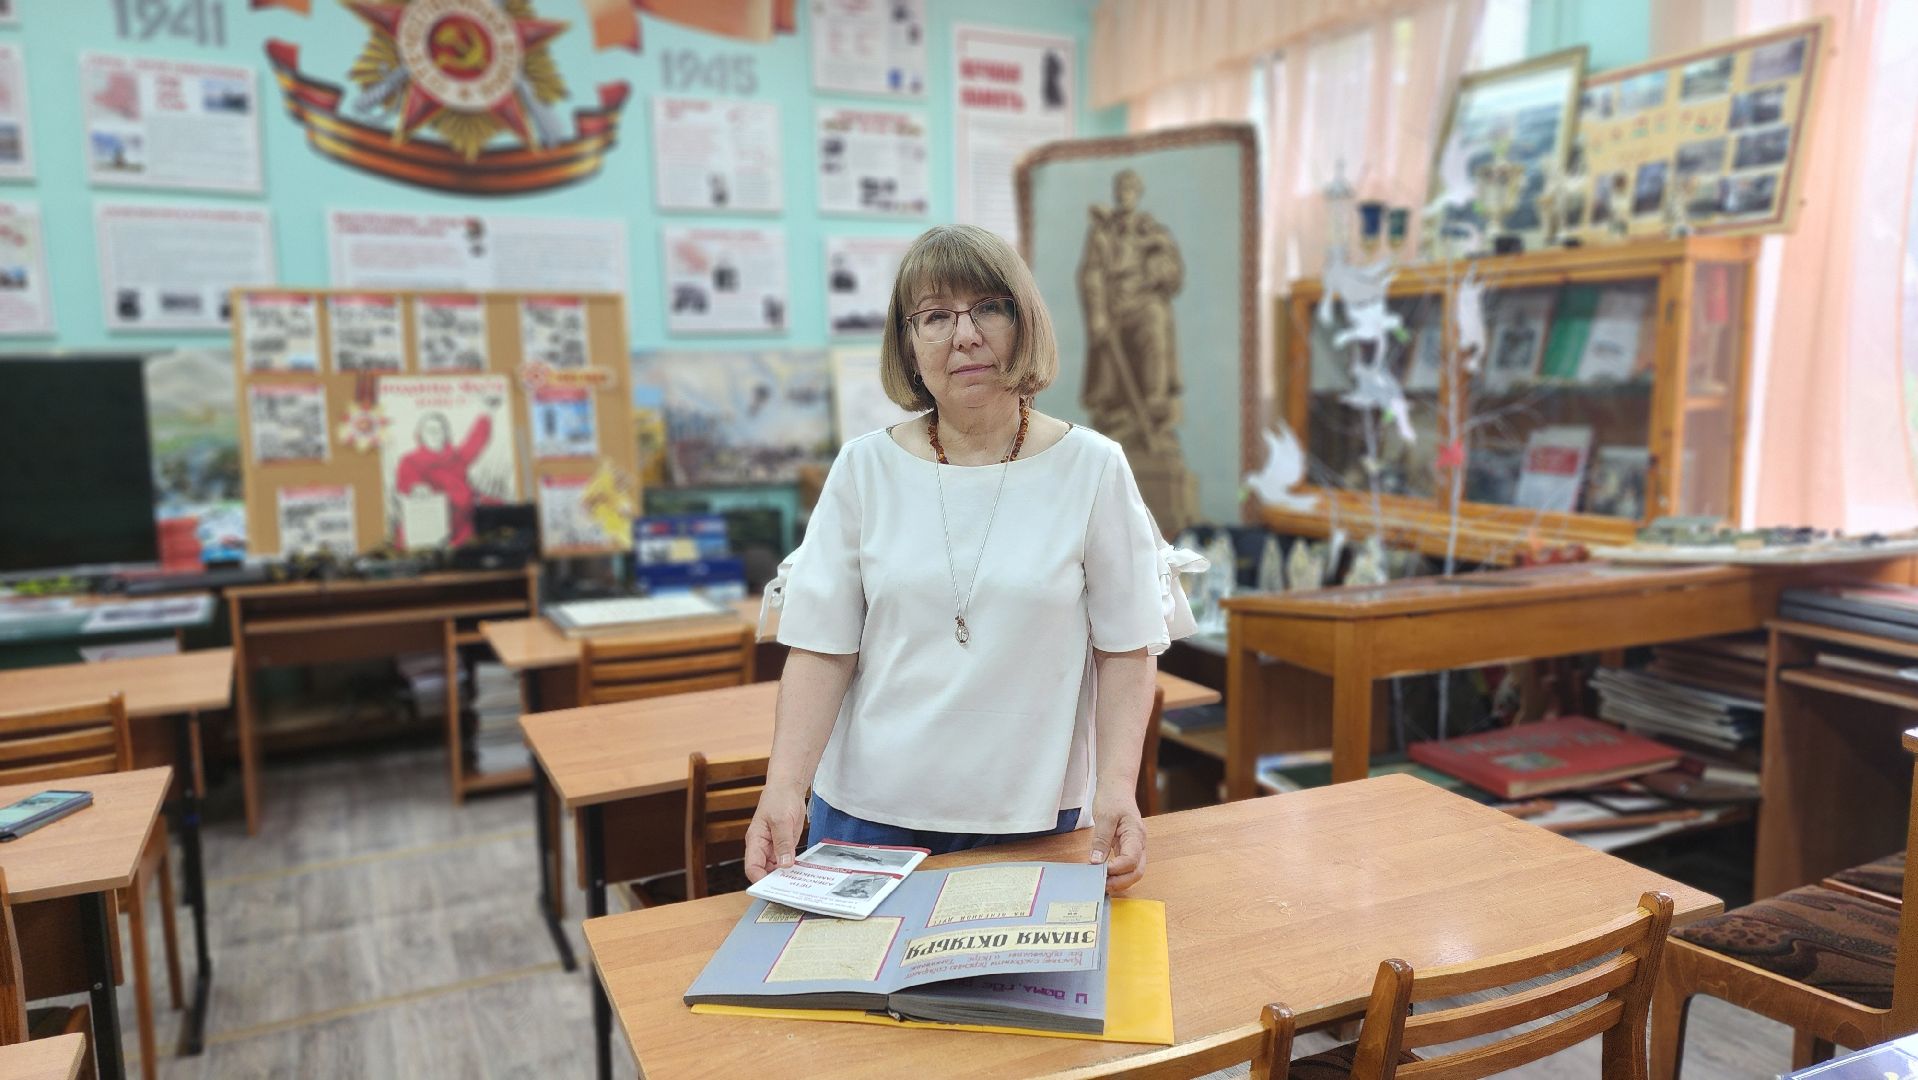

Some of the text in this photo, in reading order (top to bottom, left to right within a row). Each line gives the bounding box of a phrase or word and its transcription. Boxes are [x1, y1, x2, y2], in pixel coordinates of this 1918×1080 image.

[112, 0, 226, 47] 1941
[661, 48, 758, 96] 1945
[905, 930, 1095, 960] ЗНАМЯ ОКТЯБРЯ
